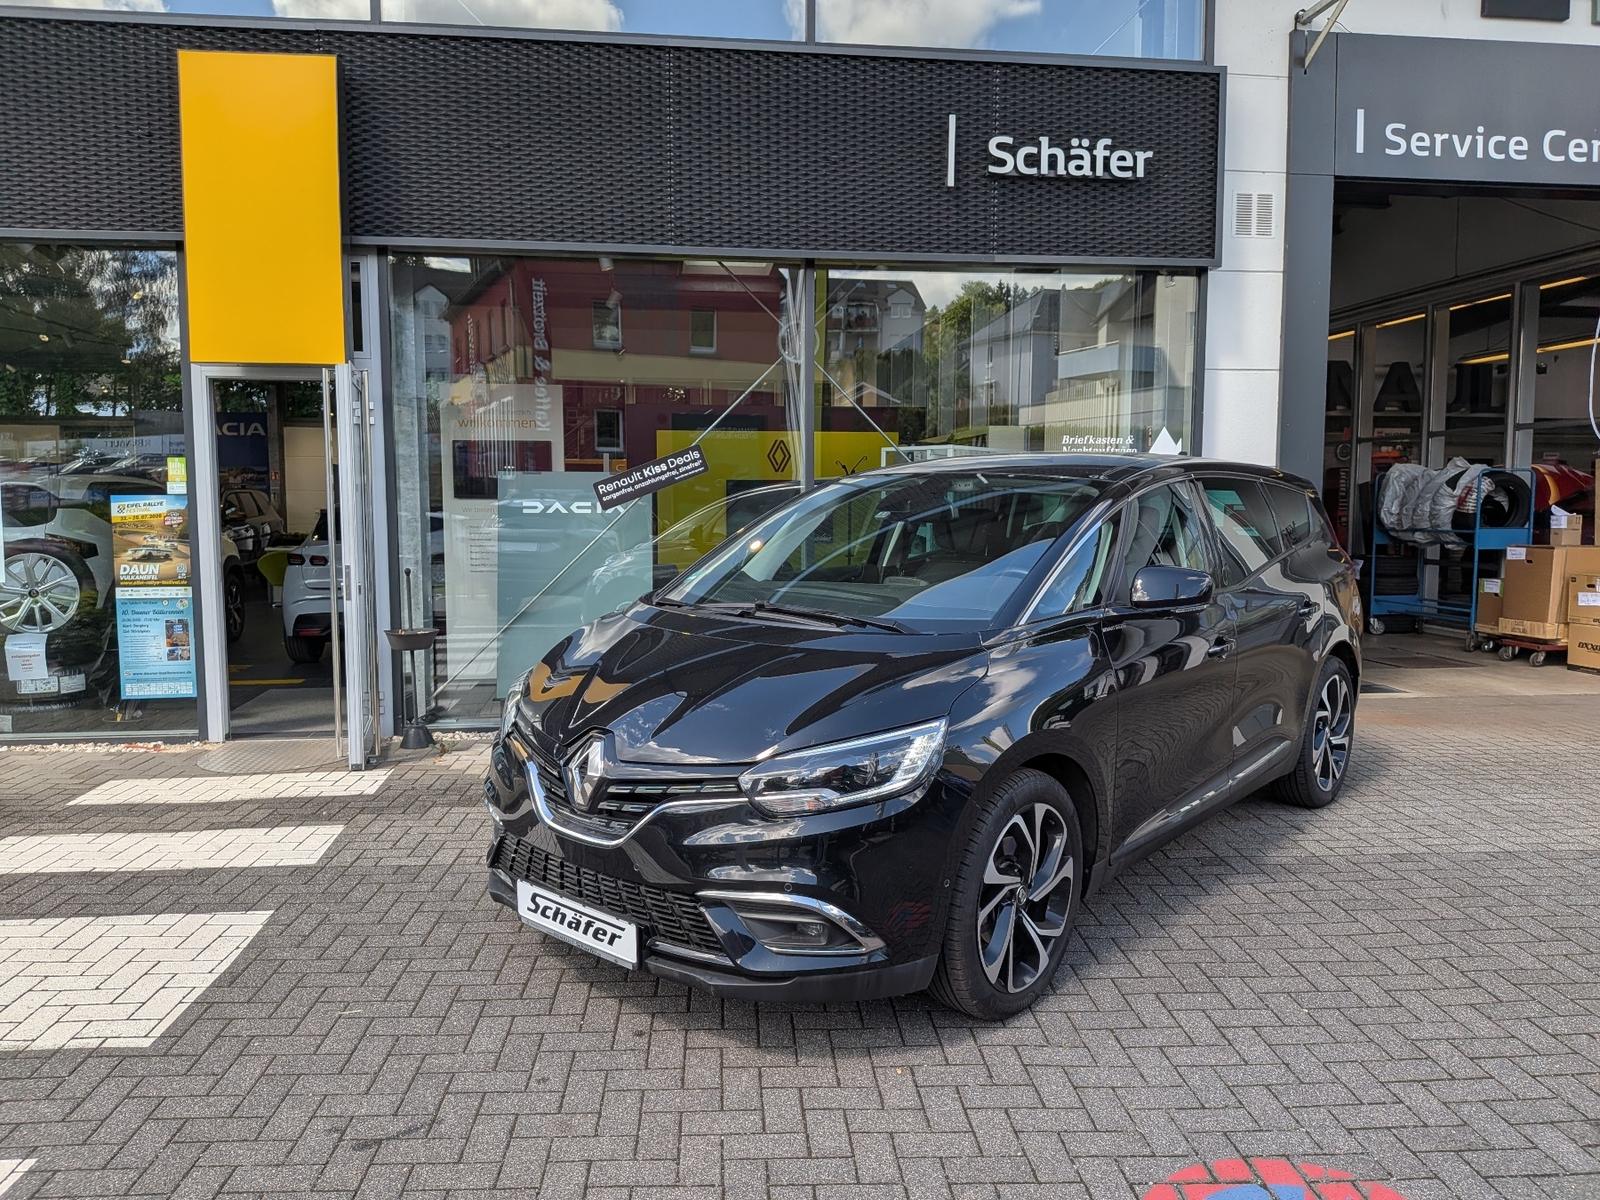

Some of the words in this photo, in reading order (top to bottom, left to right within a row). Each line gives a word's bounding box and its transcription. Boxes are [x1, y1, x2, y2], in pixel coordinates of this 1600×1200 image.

[988, 136, 1154, 178] Schäfer
[1385, 123, 1529, 161] Service
[1062, 435, 1123, 445] Briefkasten
[1126, 435, 1135, 445] &
[597, 471, 644, 495] Renault
[642, 462, 668, 478] Kiss
[667, 450, 701, 468] Deals
[120, 564, 160, 575] DAUN
[527, 892, 626, 947] Schäfer
